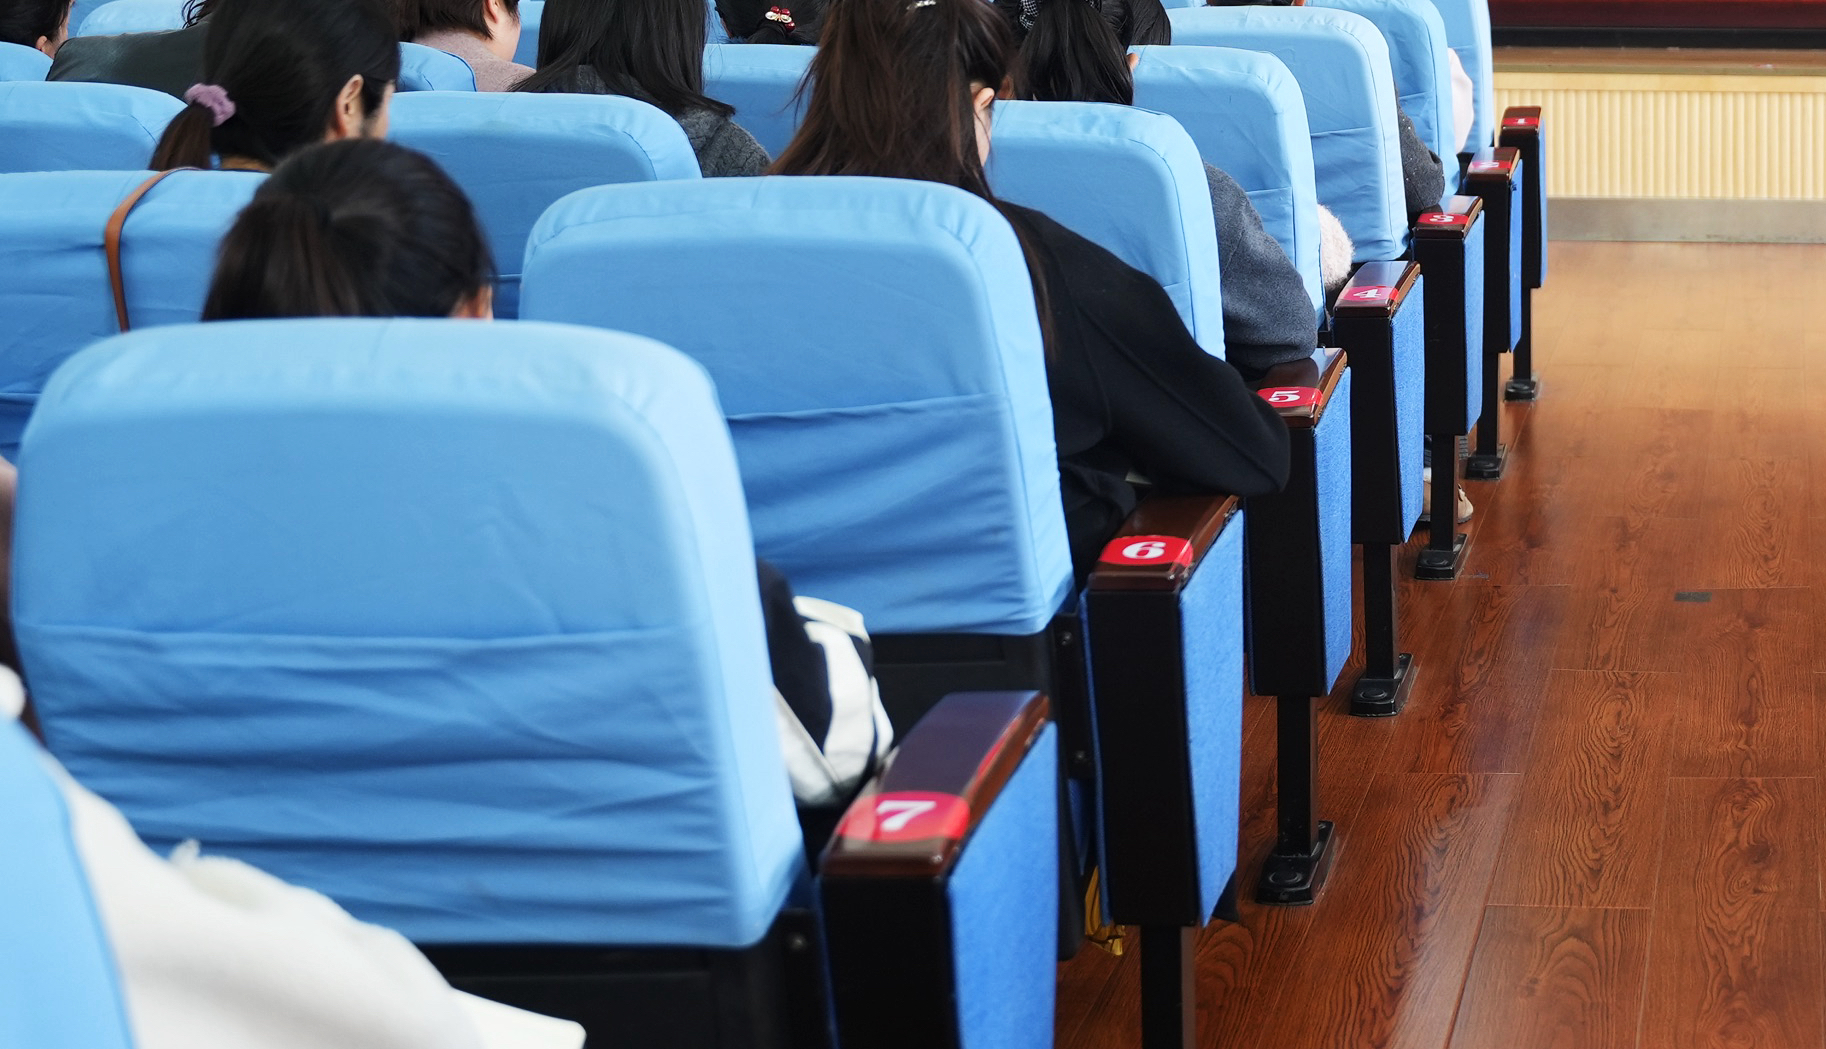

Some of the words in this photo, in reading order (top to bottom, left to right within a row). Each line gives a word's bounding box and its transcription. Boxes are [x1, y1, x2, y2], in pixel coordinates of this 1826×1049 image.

[1429, 215, 1454, 223] 3
[1353, 288, 1381, 299] 4
[1268, 390, 1301, 403] 5
[1121, 541, 1167, 559] 6
[876, 800, 937, 832] 7
